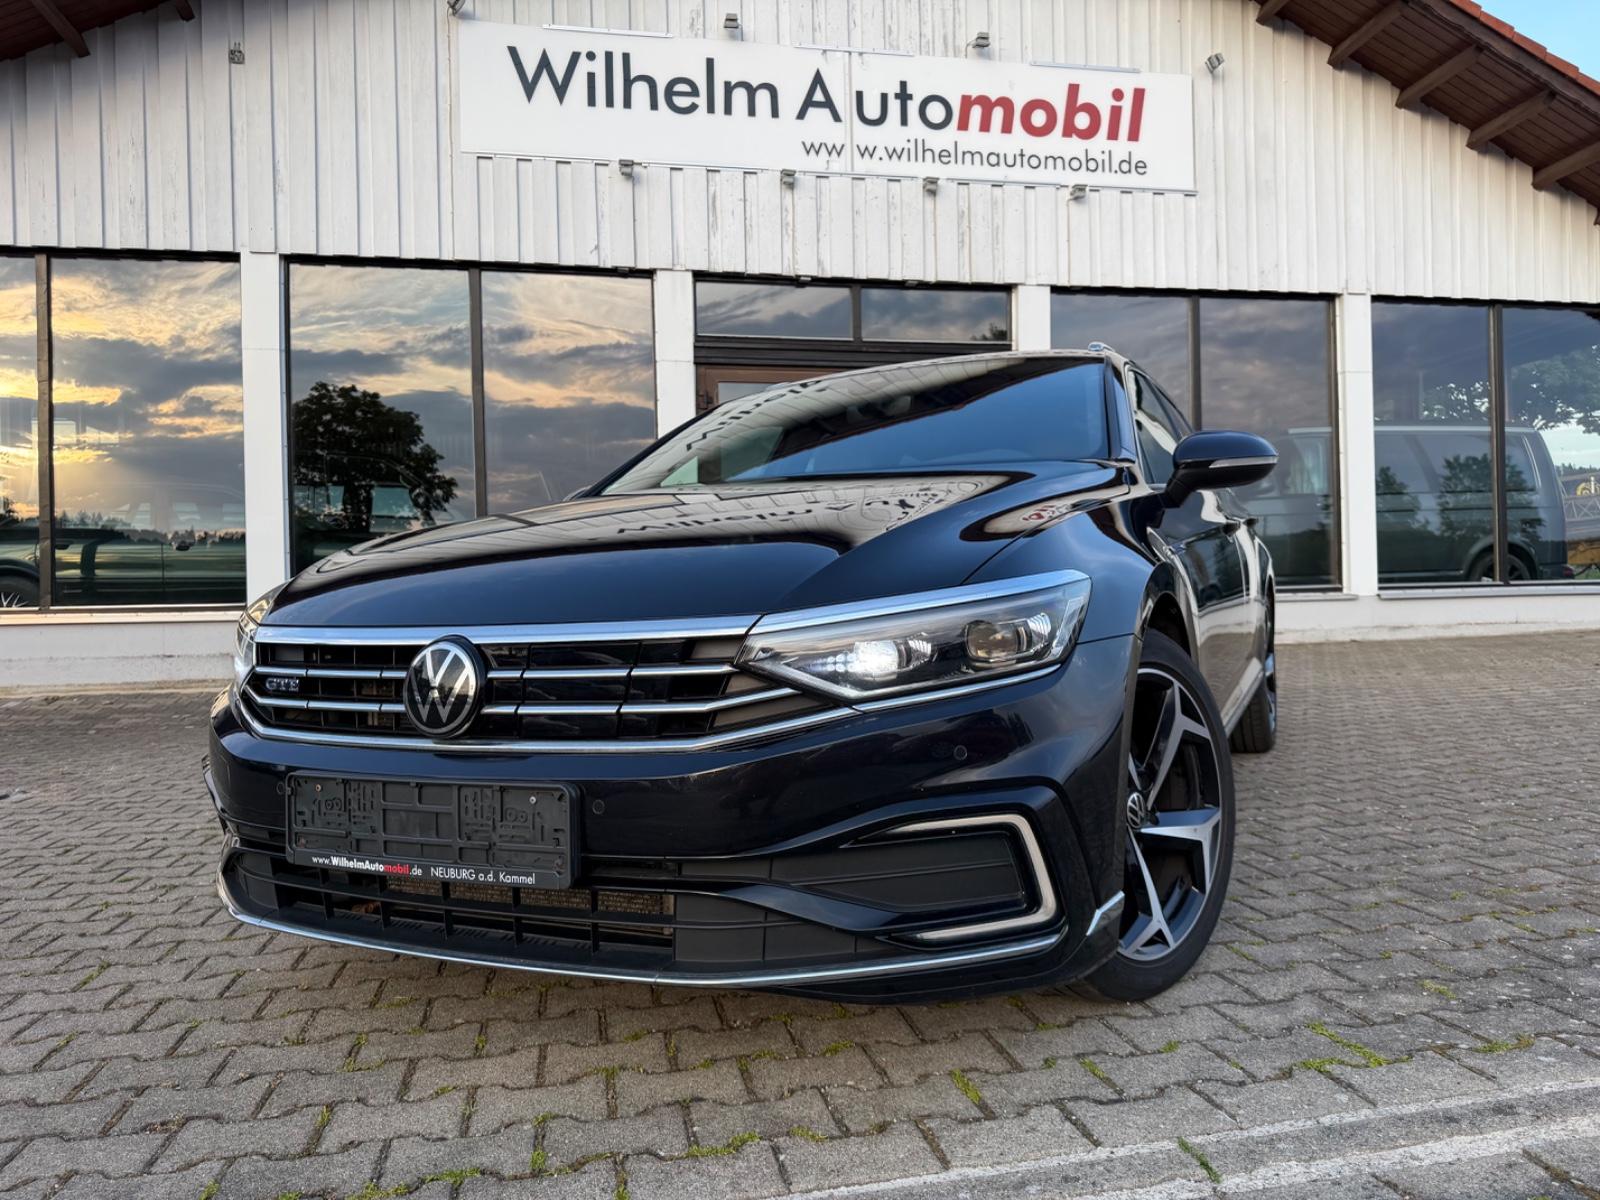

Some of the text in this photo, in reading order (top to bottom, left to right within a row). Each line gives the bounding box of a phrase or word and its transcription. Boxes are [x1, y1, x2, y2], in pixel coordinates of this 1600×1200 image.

[506, 45, 1146, 143] Wilhelm Automobil
[311, 856, 536, 885] www.WilhelmAutomobil.de NEUBURG a.d. Kammel
